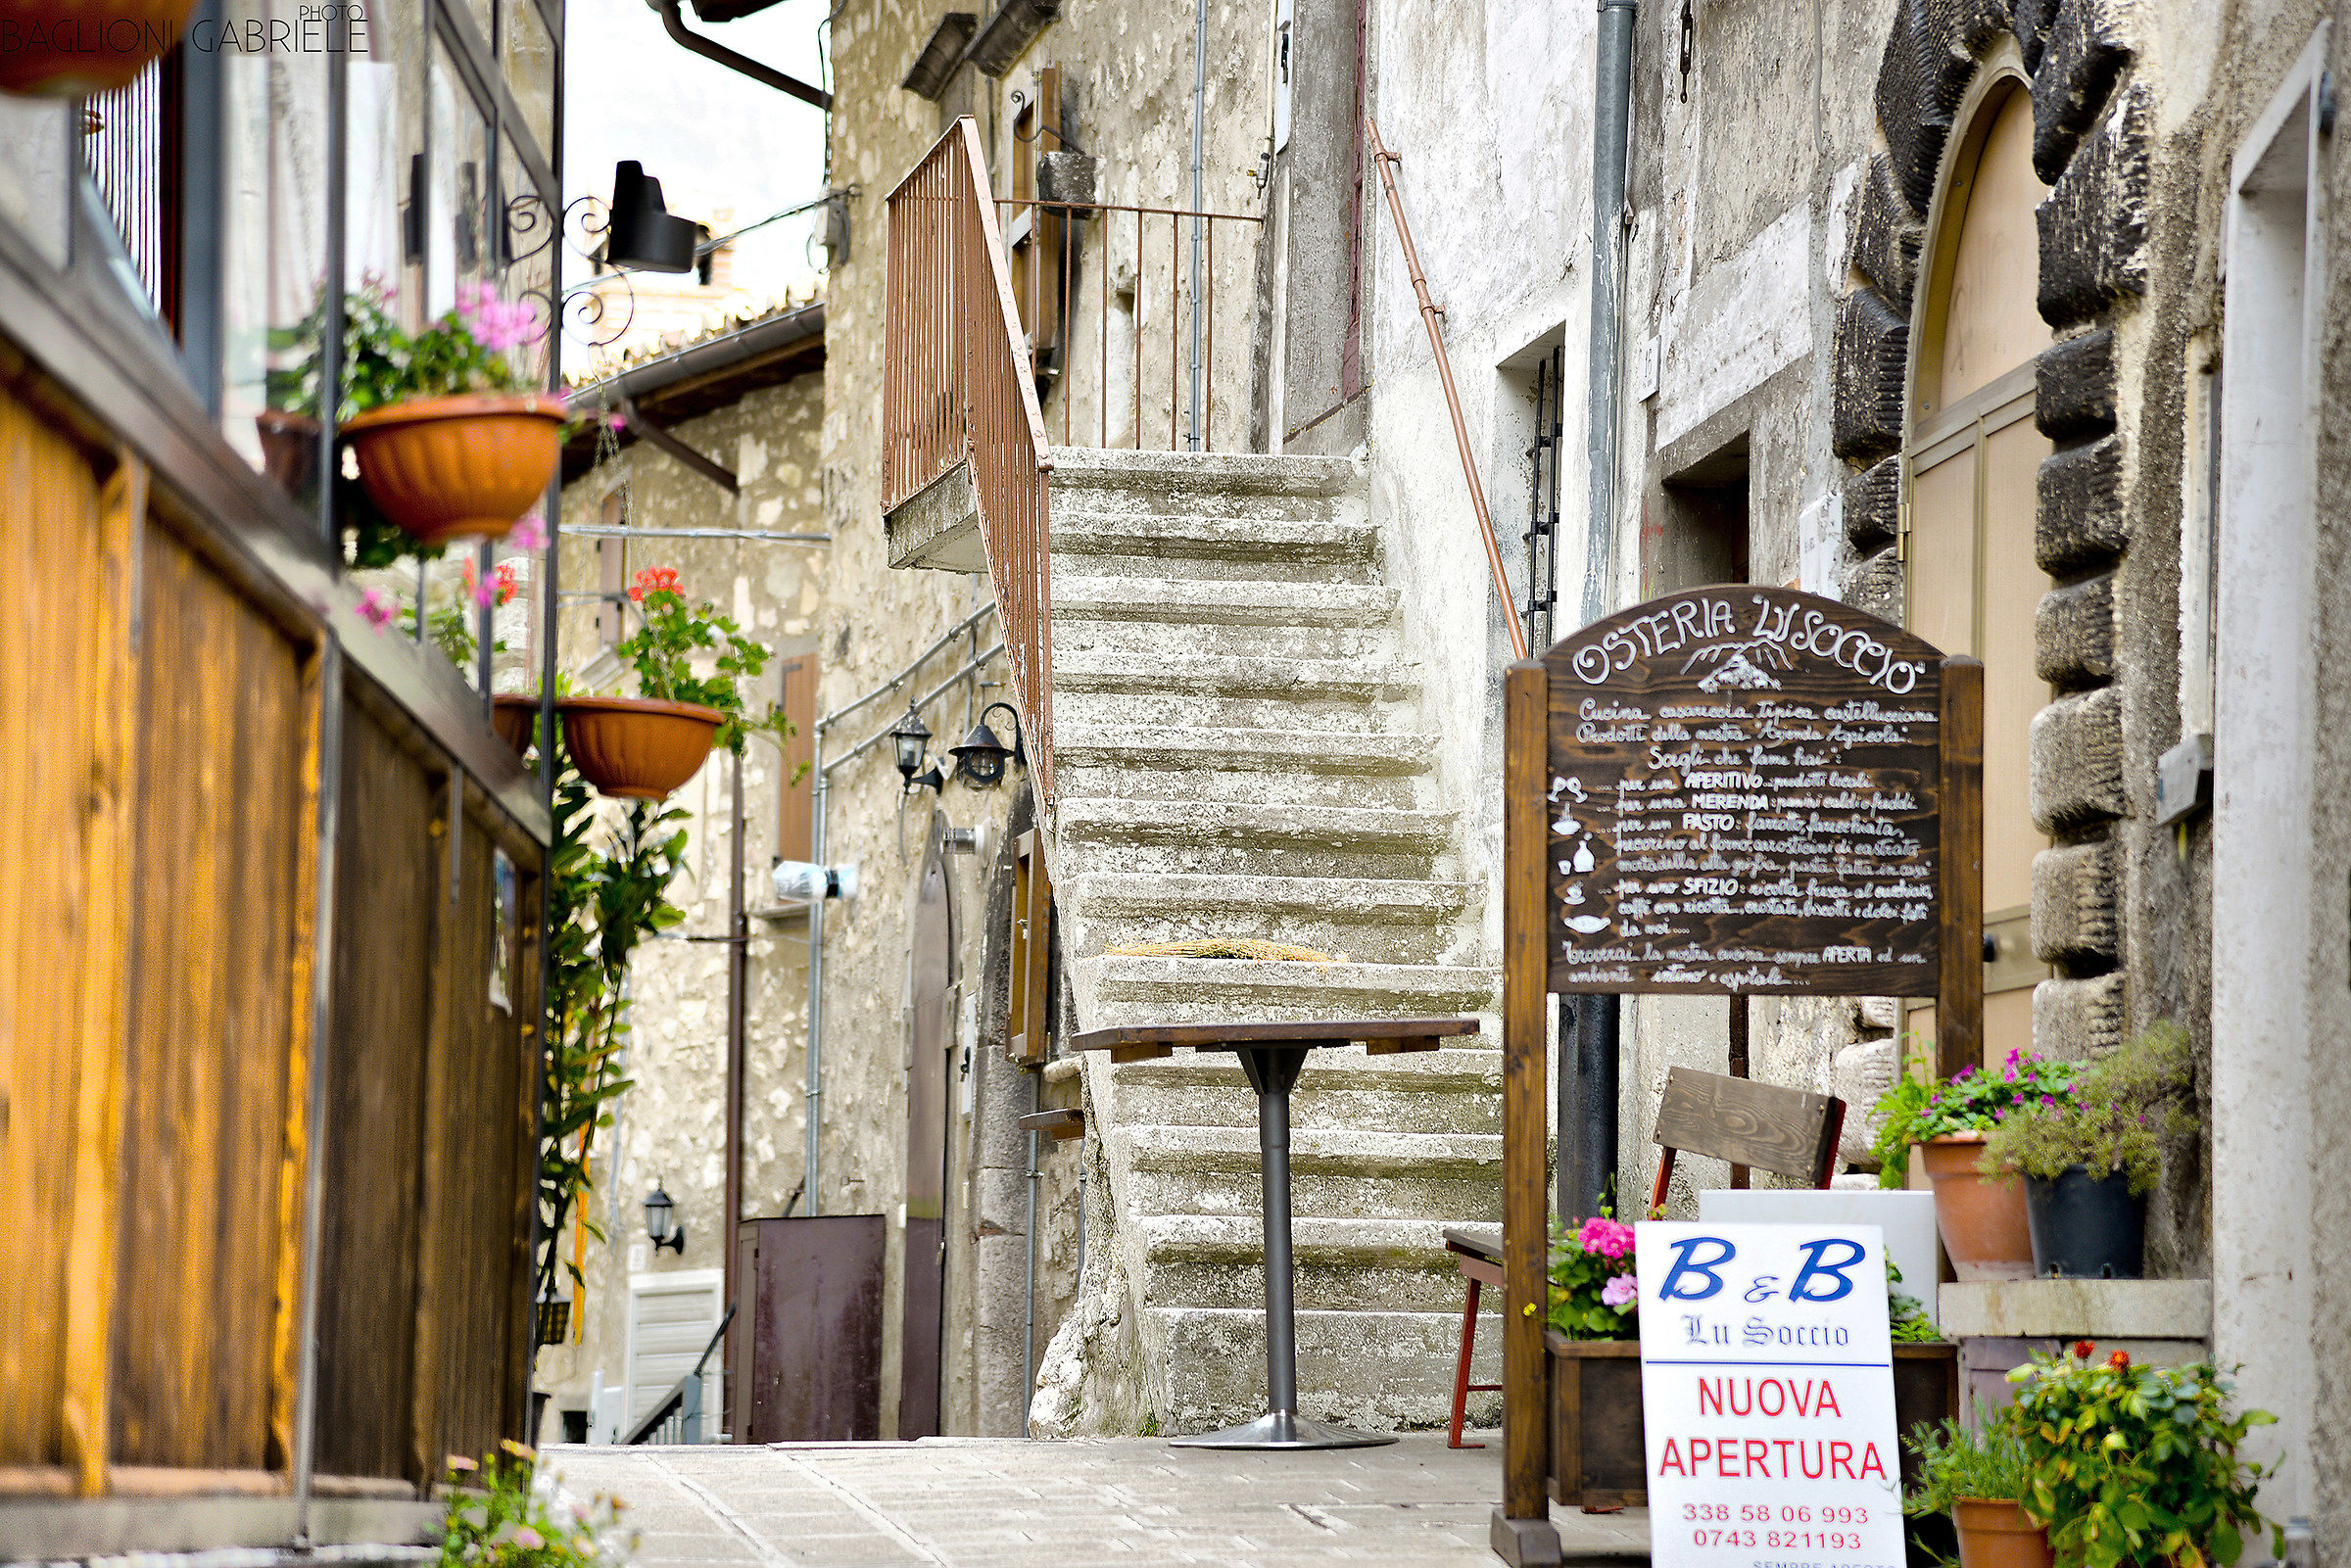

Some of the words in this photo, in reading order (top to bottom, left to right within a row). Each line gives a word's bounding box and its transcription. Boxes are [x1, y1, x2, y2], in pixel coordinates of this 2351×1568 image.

[1572, 597, 1736, 685] OSTERIA
[1578, 697, 1653, 721] Cucina
[1659, 702, 1753, 719] casareccia
[1824, 699, 1940, 723] castellucciana
[1575, 721, 1650, 743] Prodotti
[1651, 724, 1692, 741] della
[1695, 722, 1751, 741] nostra
[1647, 741, 1711, 777] Scegli
[1713, 745, 1744, 765] che
[1648, 779, 1679, 790] un
[1828, 770, 1876, 788] locali
[1647, 797, 1688, 810] una
[1776, 791, 1822, 815] panini
[1822, 790, 1860, 809] caldi
[1647, 819, 1672, 831] un
[1613, 834, 1688, 857] pecorino
[1688, 832, 1708, 851] al
[1752, 834, 1834, 855] arrosticini
[1834, 838, 1853, 855] di
[1616, 850, 1699, 873] mortadella
[1700, 852, 1731, 871] alla
[1787, 855, 1835, 883] pasta
[1875, 862, 1899, 876] in
[1645, 881, 1679, 895] uno
[1749, 877, 1805, 898] ricotta
[1805, 877, 1854, 903] fresca
[1853, 881, 1875, 899] al
[1654, 901, 1682, 915] con
[1803, 897, 1852, 918] biscotti
[1861, 902, 1899, 920] dolci
[1899, 902, 1931, 926] fatti
[1619, 918, 1643, 938] da
[1642, 941, 1665, 961] la
[1665, 940, 1716, 963] nostra
[1716, 944, 1772, 962] cucina
[1772, 950, 1822, 969] sempre
[1821, 945, 1872, 964] APERTA
[1876, 946, 1894, 963] ed
[1897, 953, 1928, 964] un
[1567, 964, 1636, 983] ambiente
[1650, 963, 1707, 983] intimo
[1708, 973, 1718, 983] e
[1658, 1236, 1737, 1302] B
[1744, 1275, 1780, 1304] &
[1788, 1238, 1866, 1303] B
[1681, 1314, 1730, 1346] Lu
[1743, 1315, 1849, 1347] Soccio
[1699, 1377, 1843, 1418] NUOVA
[1658, 1437, 1888, 1481] APERTURA
[1683, 1503, 1730, 1521] 338
[1742, 1504, 1770, 1522] 58
[1781, 1506, 1811, 1523] 06
[1822, 1506, 1868, 1524] 993
[1694, 1529, 1756, 1547] 0743
[1767, 1531, 1862, 1549] 821193
